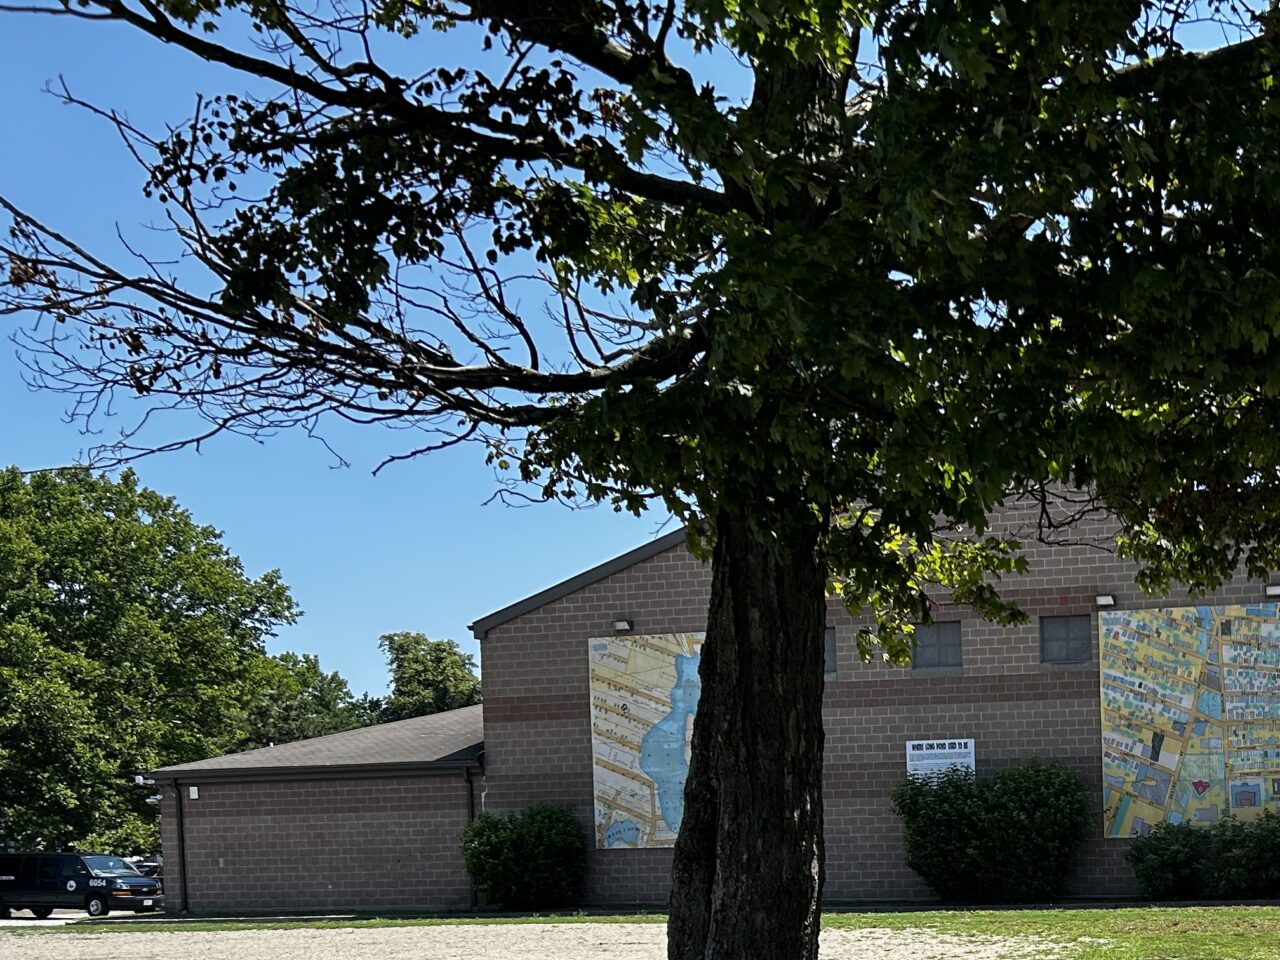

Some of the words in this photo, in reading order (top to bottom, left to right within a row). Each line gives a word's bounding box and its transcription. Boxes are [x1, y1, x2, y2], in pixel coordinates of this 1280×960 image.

[925, 742, 936, 750] LONG
[963, 742, 968, 750] BE
[90, 878, 106, 887] 6054
